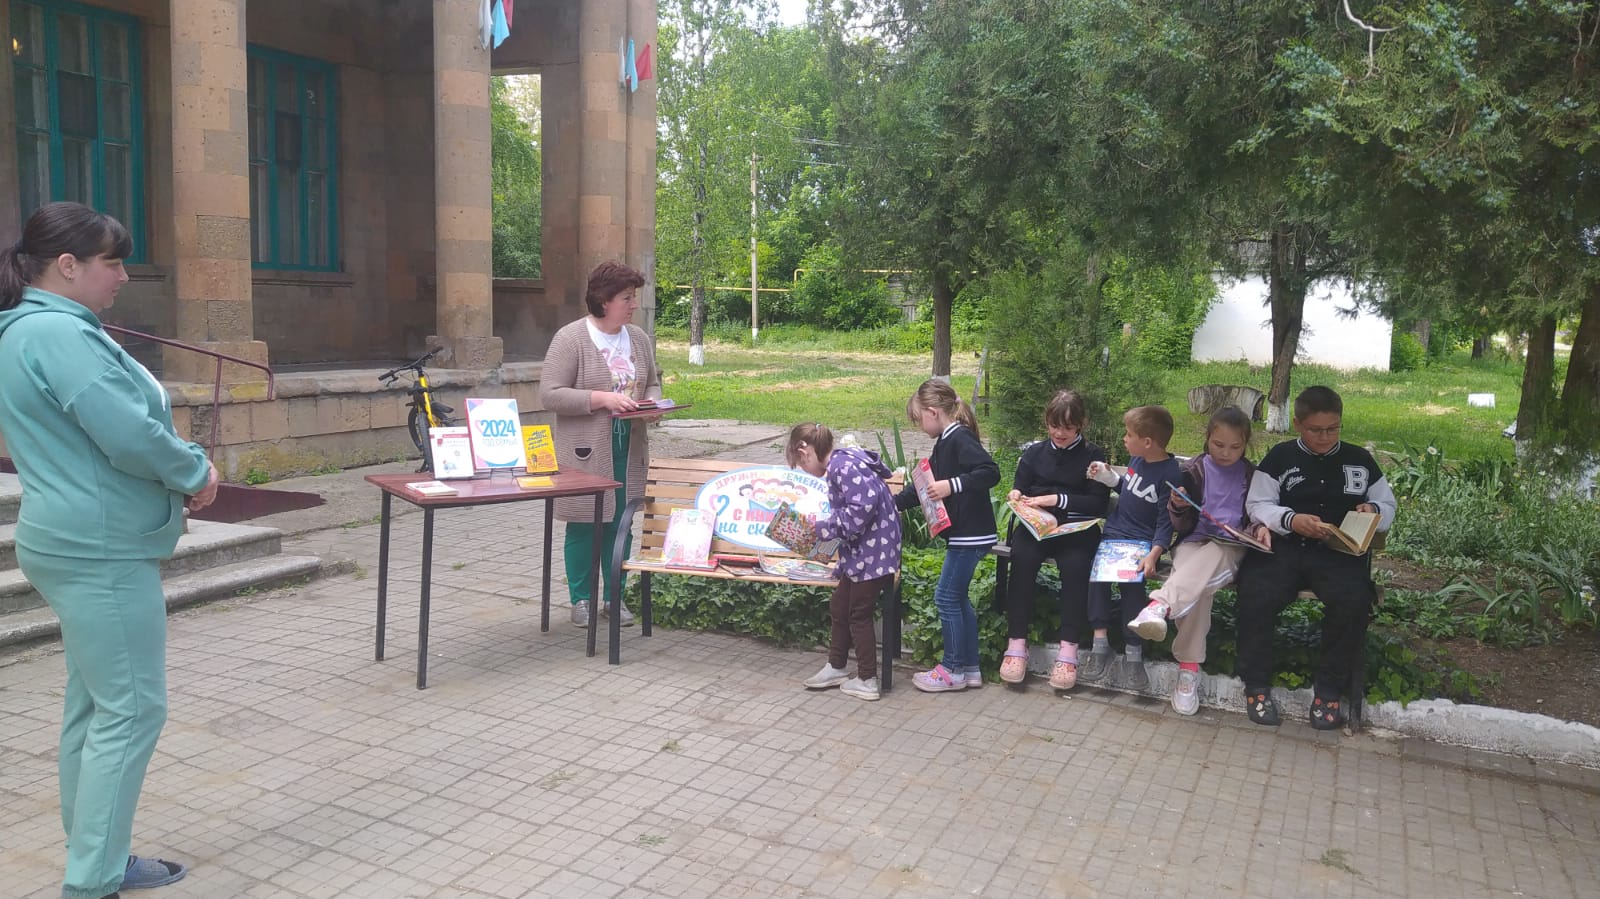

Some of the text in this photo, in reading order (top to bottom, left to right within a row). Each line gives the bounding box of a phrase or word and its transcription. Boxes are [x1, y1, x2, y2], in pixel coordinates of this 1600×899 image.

[480, 419, 517, 437] 2024
[715, 472, 774, 490] ДРУЖН
[1343, 464, 1370, 496] B
[719, 521, 738, 534] на
